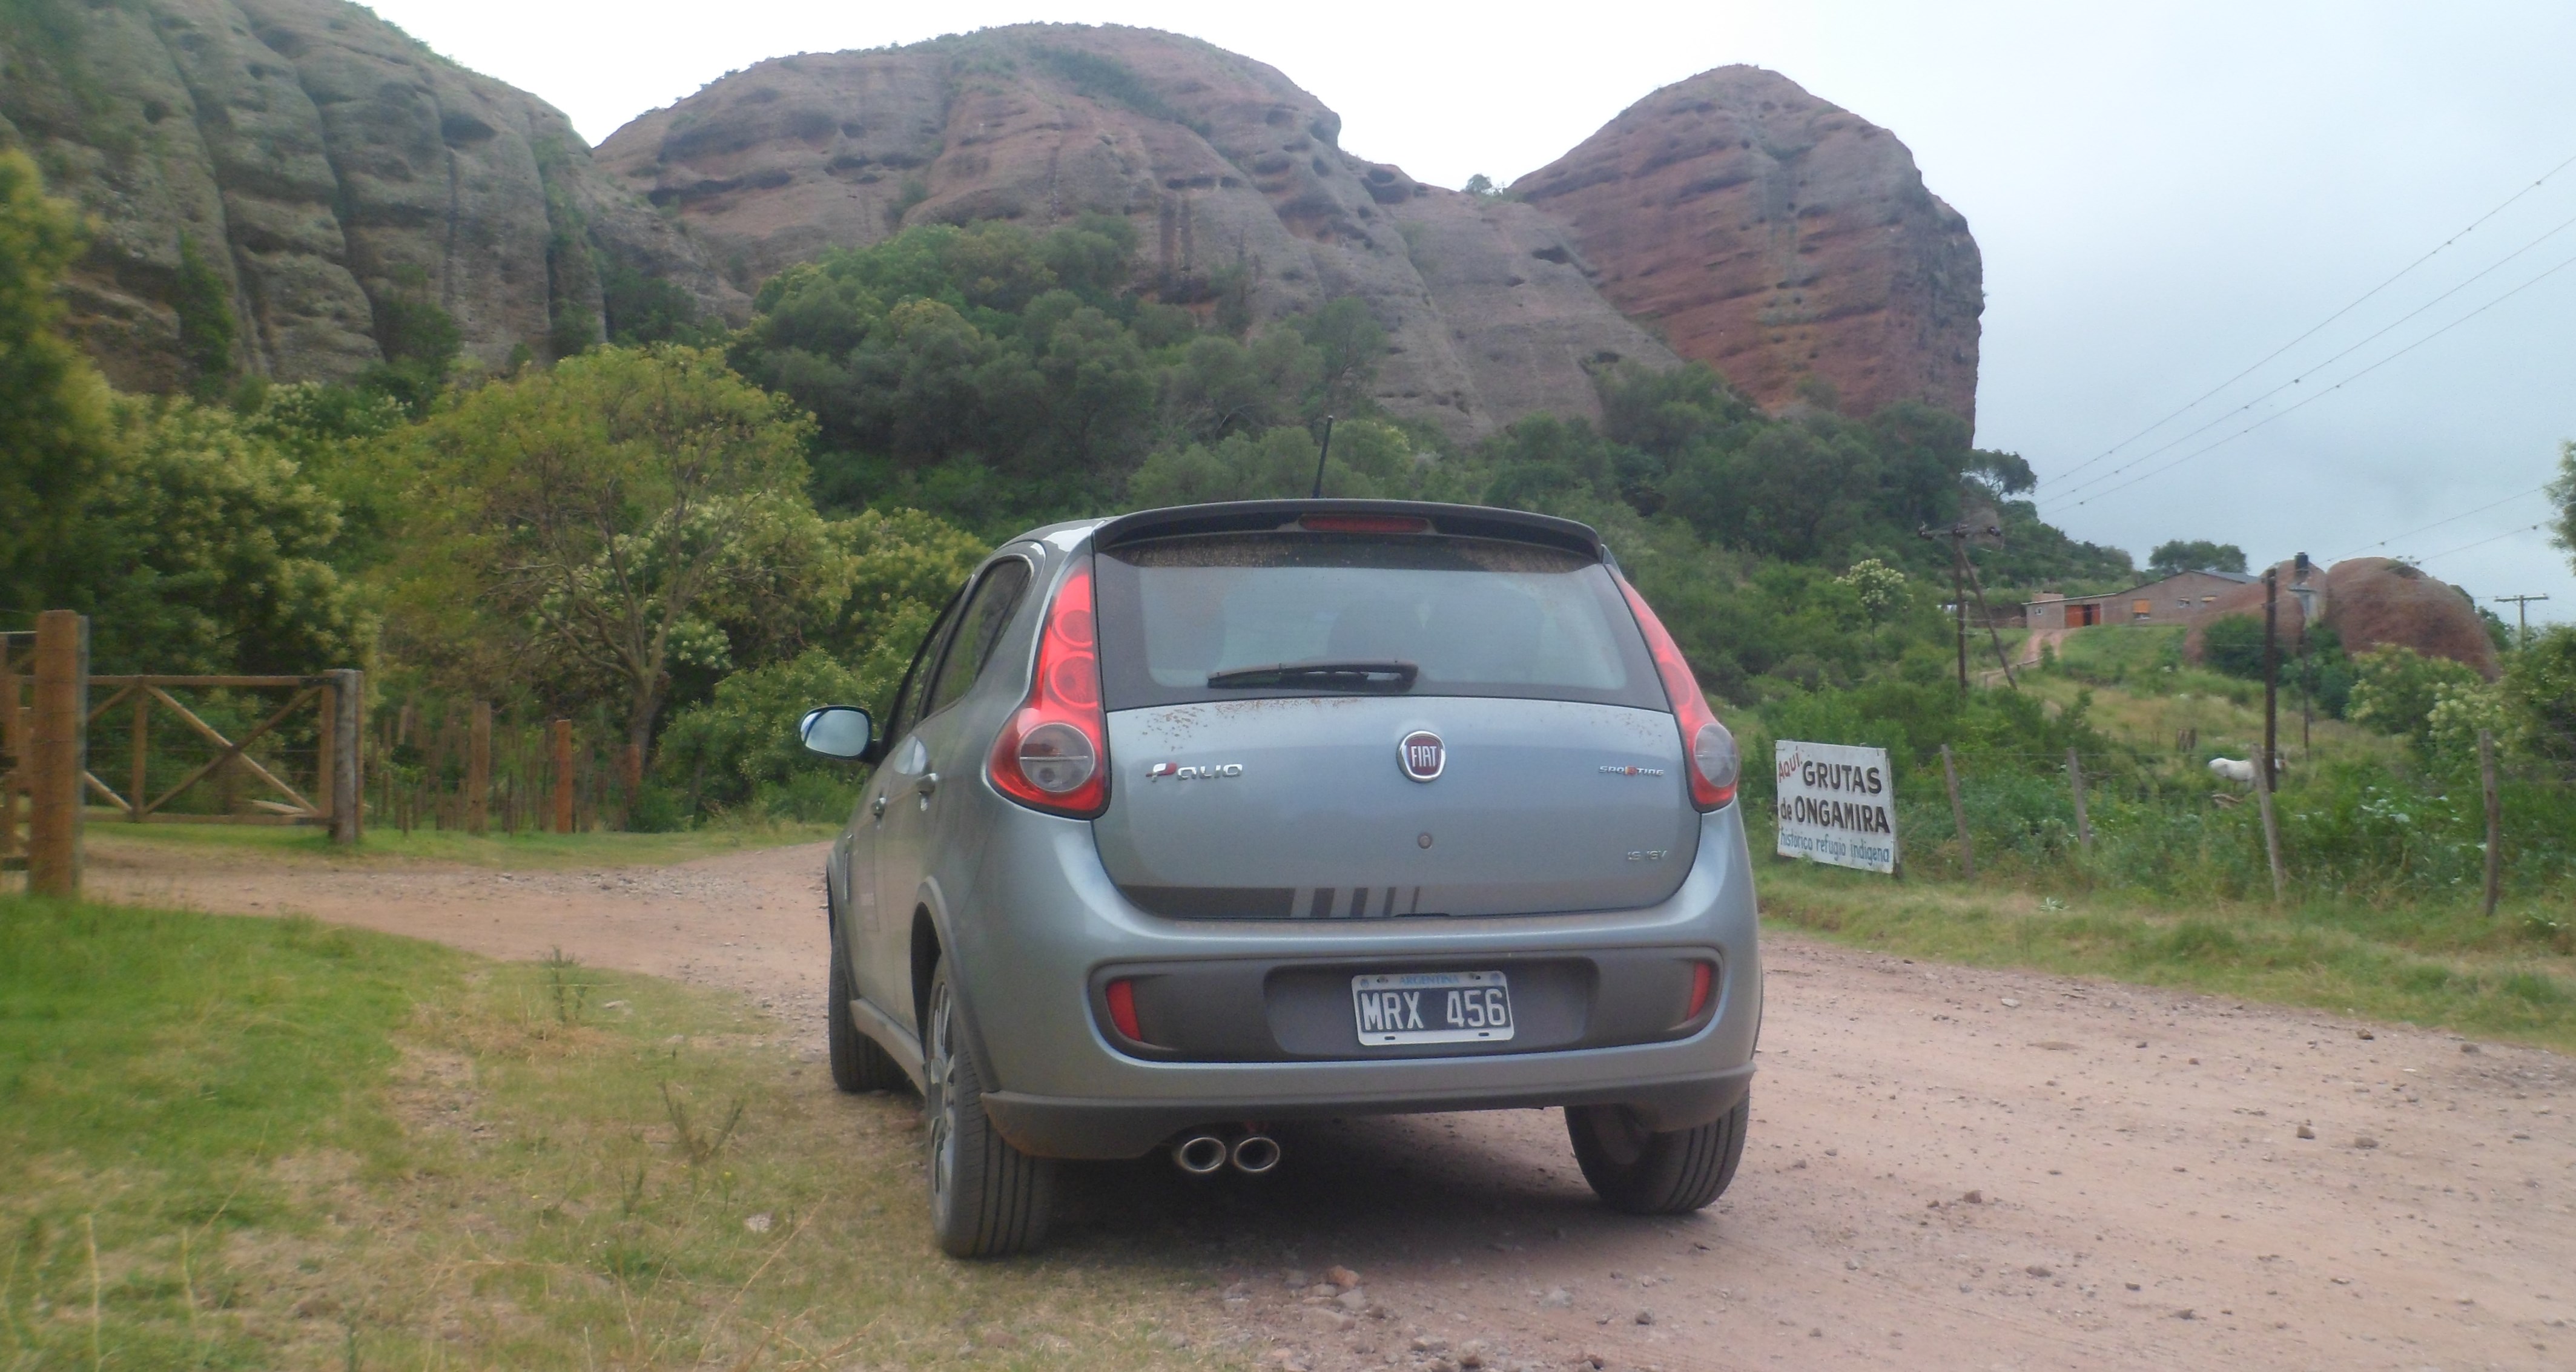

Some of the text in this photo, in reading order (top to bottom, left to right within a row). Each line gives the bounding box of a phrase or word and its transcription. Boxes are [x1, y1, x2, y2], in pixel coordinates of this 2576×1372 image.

[1410, 745, 1437, 767] FIAT
[1803, 760, 1882, 794] GRUTAS
[1780, 796, 1891, 833] de ONGAMIRA
[1817, 833, 1846, 861] refugio
[1400, 974, 1459, 985] ARGENTINA
[1361, 989, 1506, 1030] MRX 456
